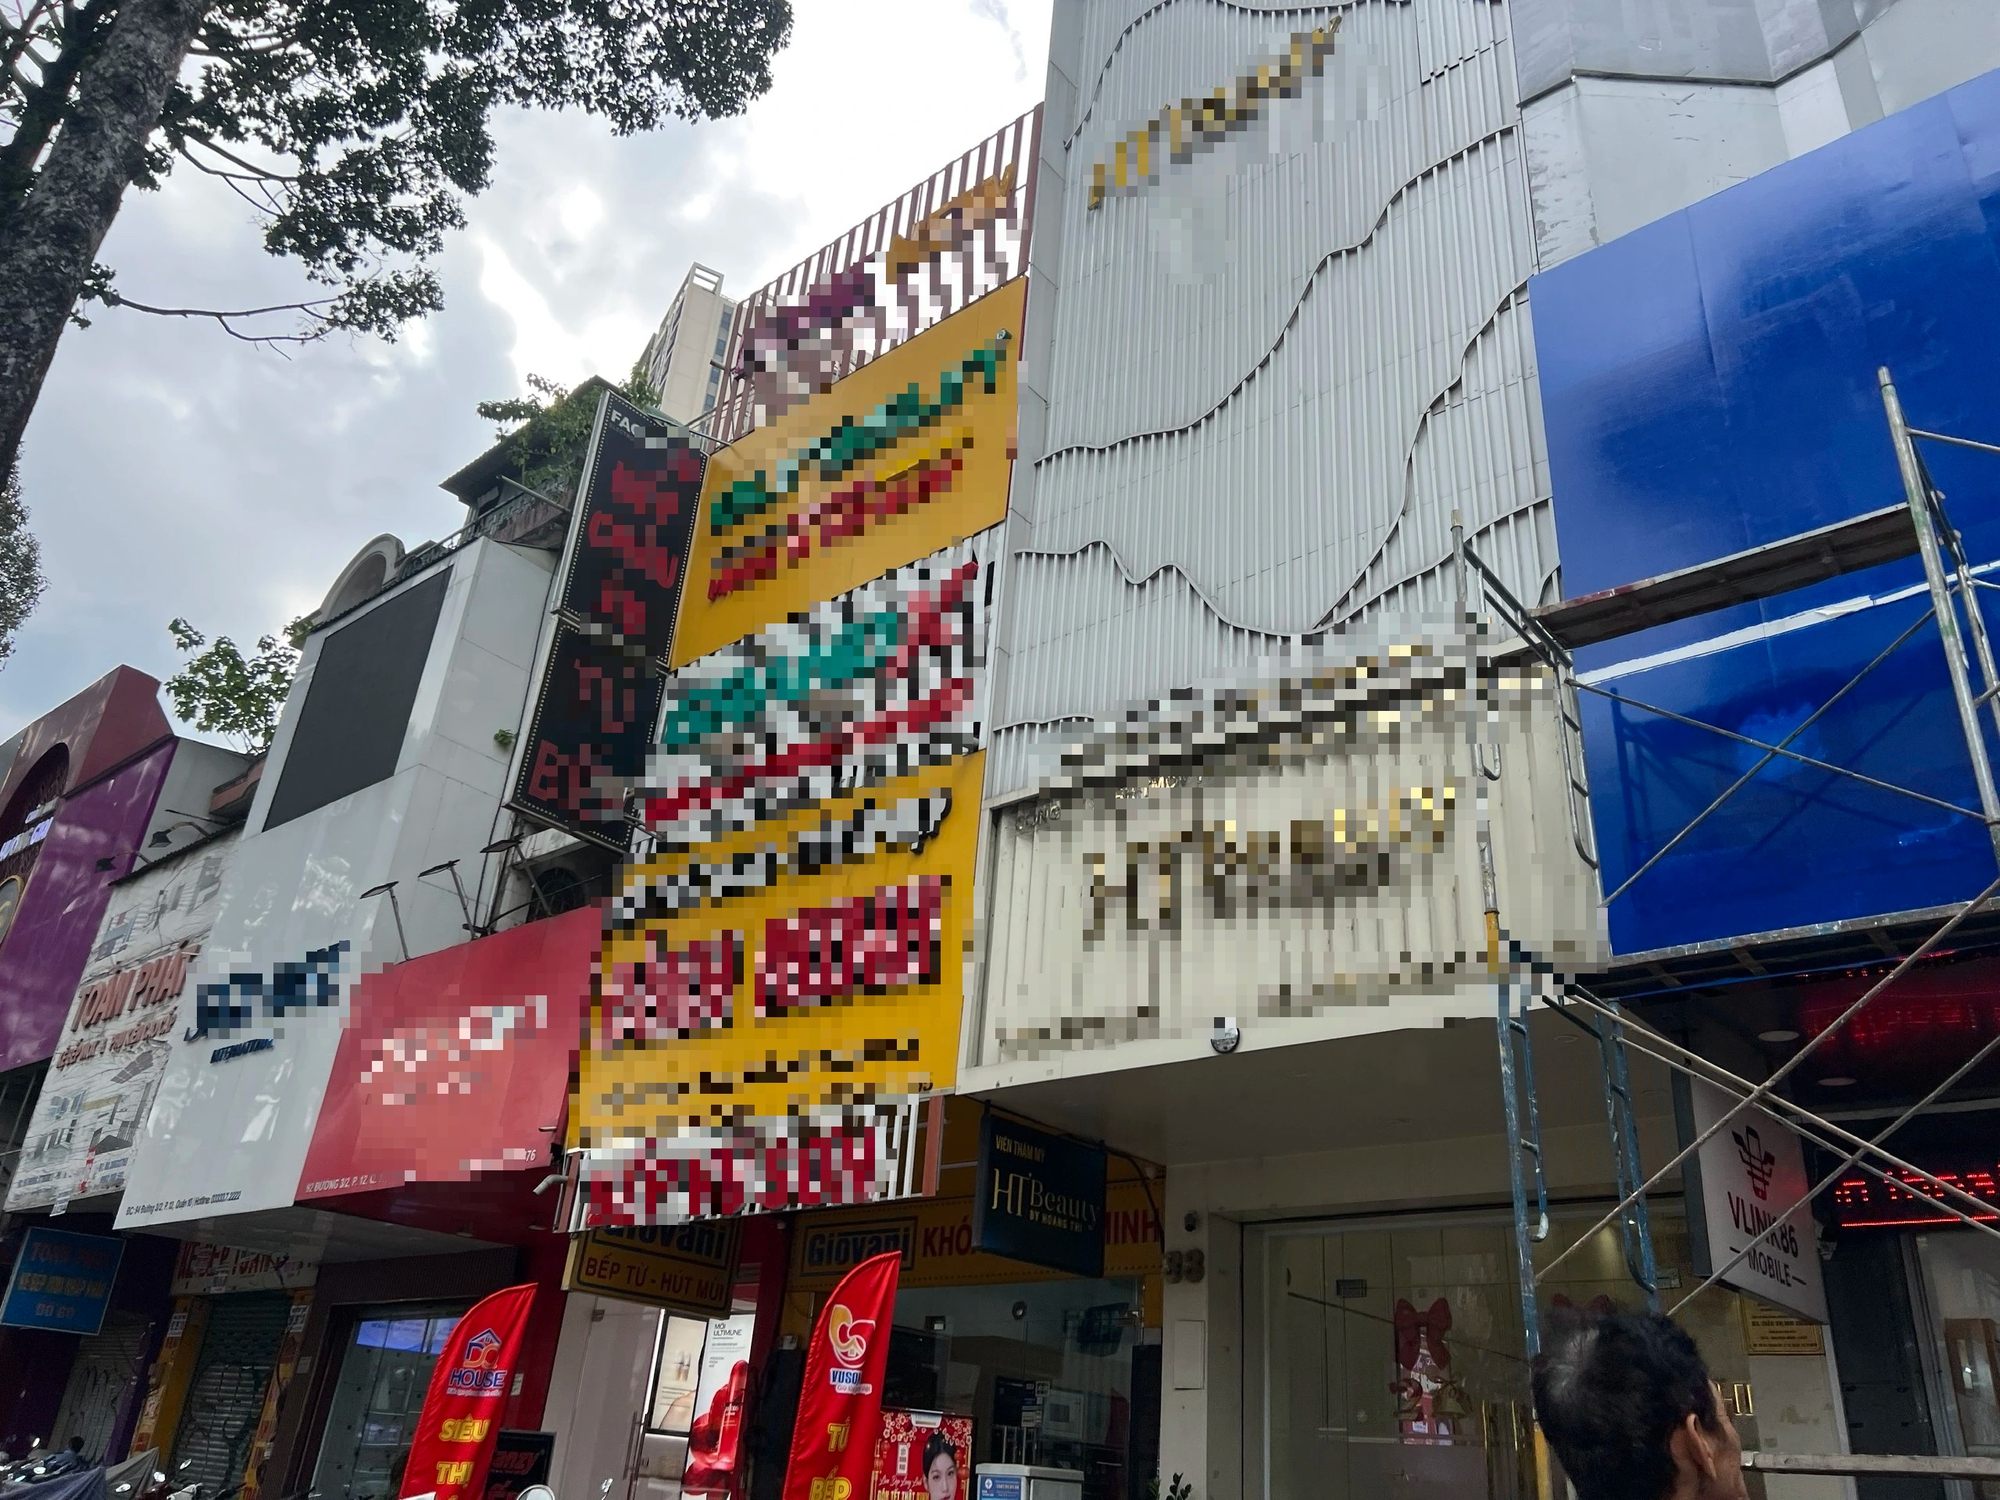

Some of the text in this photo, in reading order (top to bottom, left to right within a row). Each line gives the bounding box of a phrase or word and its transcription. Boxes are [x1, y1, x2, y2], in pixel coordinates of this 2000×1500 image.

[1030, 1179, 1100, 1231] Beauty
[922, 1215, 979, 1257] KHÓ
[1105, 1208, 1160, 1245] INH
[585, 1253, 620, 1281] BẾP
[626, 1262, 649, 1287] TỪ
[660, 1270, 693, 1295] HÚT
[1748, 1248, 1792, 1287] MOBILE
[713, 1329, 742, 1337] ULTIMUNE
[449, 1367, 507, 1389] HOUSE
[439, 1414, 490, 1442] SIÊU
[436, 1461, 475, 1489] THỊ
[809, 1465, 852, 1500] BẾP
